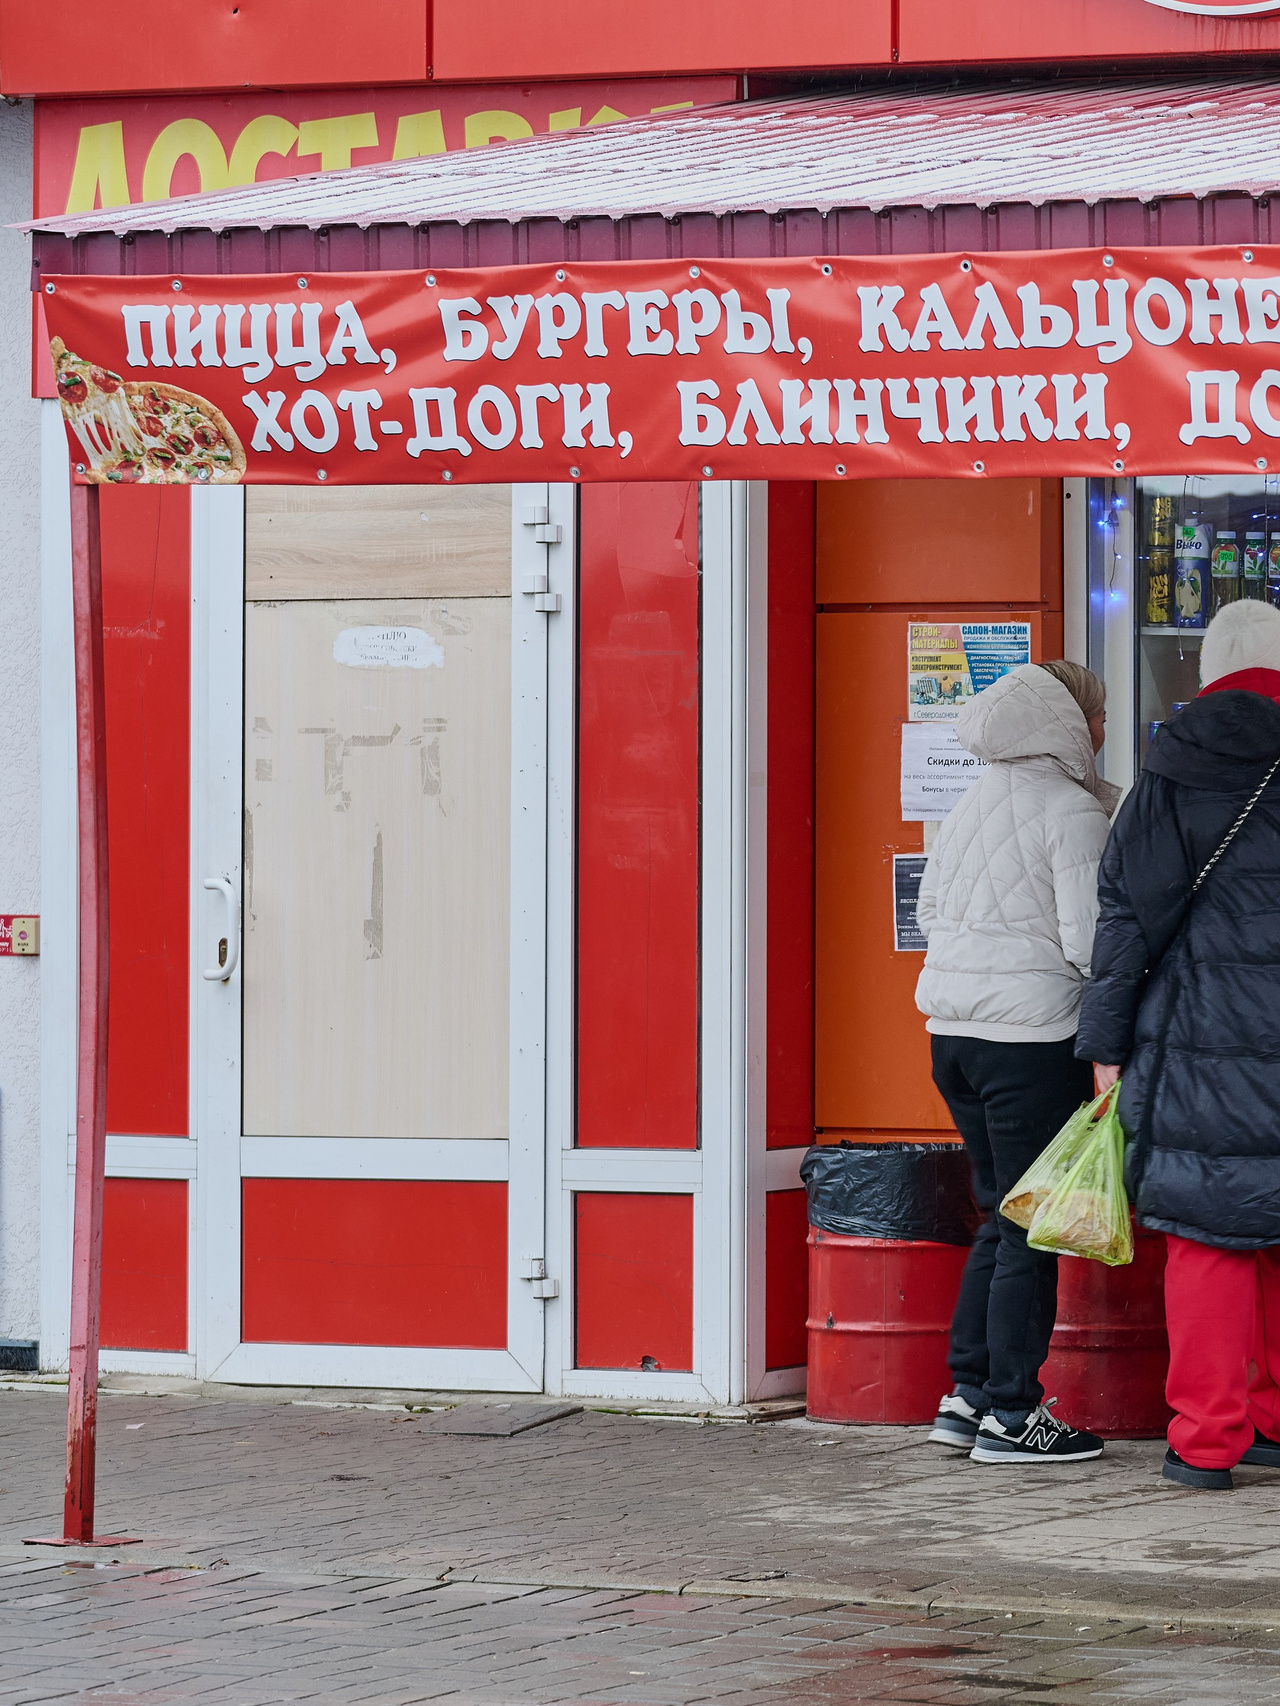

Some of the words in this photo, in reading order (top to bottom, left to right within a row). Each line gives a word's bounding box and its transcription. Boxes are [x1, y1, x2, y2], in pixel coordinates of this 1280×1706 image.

[121, 299, 398, 384] ПИЦЦА,
[438, 288, 815, 365] БУРГЕРЫ,
[242, 382, 634, 459] ХОТ-ДОГИ,
[677, 372, 1132, 452] БЛИНЧИКИ,
[962, 625, 1028, 635] САЛОН-МАГАЗИН
[912, 638, 958, 649] МАТЕРИАЛЫ
[927, 756, 960, 767] Скидки
[962, 757, 975, 767] до
[922, 786, 945, 794] Бонусы
